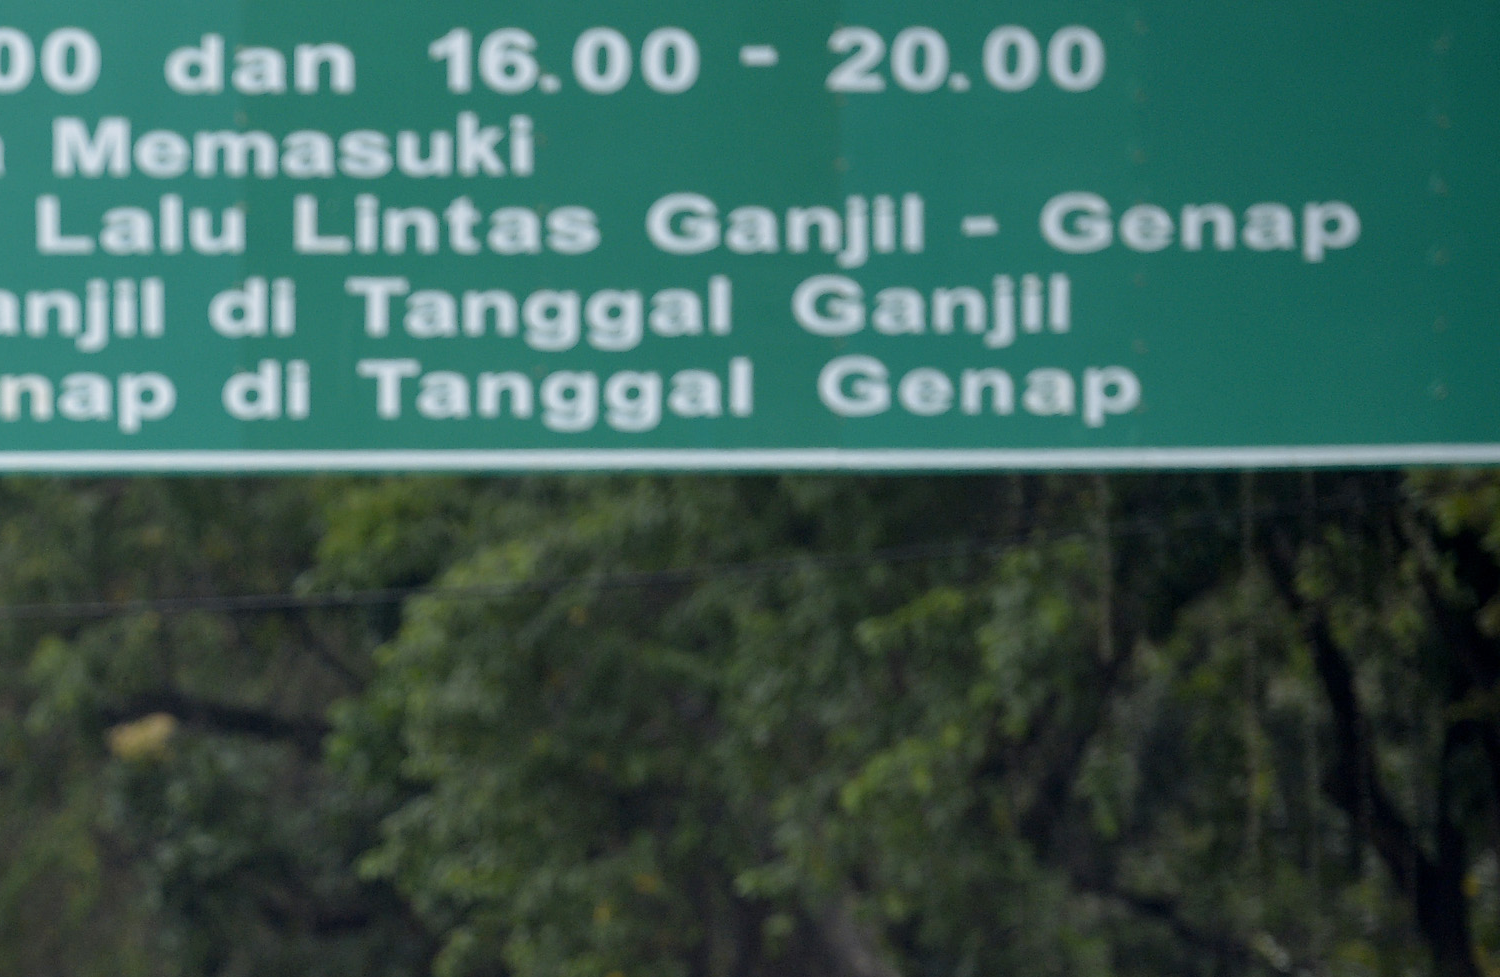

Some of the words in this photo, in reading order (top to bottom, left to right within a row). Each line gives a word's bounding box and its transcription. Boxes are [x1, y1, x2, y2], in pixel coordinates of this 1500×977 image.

[164, 33, 355, 94] dan
[429, 26, 700, 93] 16.00
[826, 25, 1105, 92] 20.00
[52, 111, 533, 178] Memasuki
[36, 194, 245, 255] Lalu
[293, 194, 600, 255] Lintas
[646, 193, 924, 268] Ganjil
[1039, 191, 1360, 262] Genap
[209, 277, 295, 337] di
[345, 276, 731, 351] Tanggal
[792, 273, 1070, 348] Ganjil
[222, 359, 310, 420] di
[358, 357, 753, 432] Tanggal
[817, 355, 1141, 428] Genap
